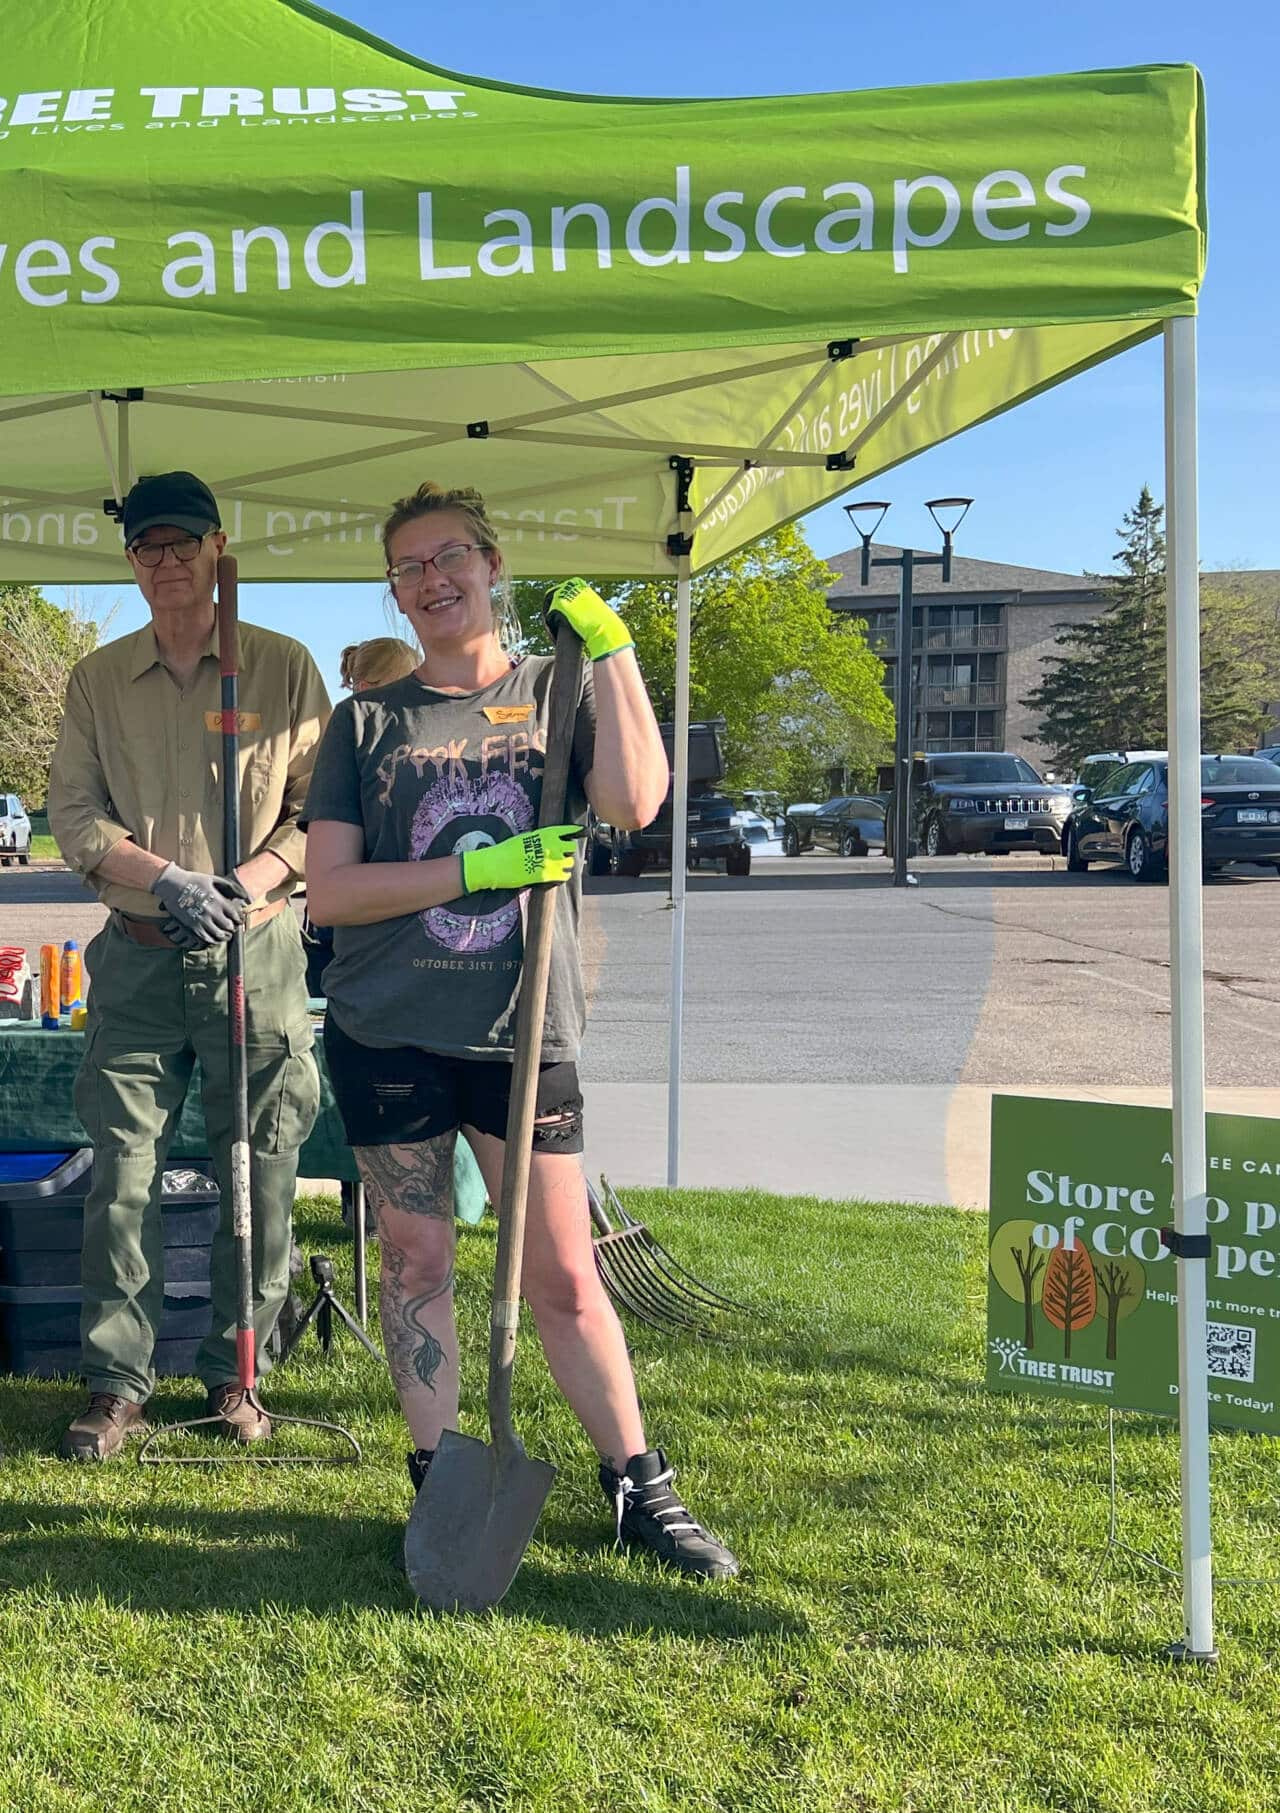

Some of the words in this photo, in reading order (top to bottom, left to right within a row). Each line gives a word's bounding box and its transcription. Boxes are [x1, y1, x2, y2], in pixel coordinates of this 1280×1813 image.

[139, 86, 466, 118] TRUST
[30, 122, 125, 136] Lives
[144, 118, 218, 130] and
[241, 111, 479, 127] Landscapes
[161, 190, 367, 298] and
[418, 164, 1091, 281] Landscapes
[413, 958, 465, 970] OCTOBER
[1026, 1170, 1155, 1216] Store
[1032, 1216, 1086, 1253] of
[1225, 1302, 1266, 1317] more
[1017, 1358, 1057, 1380] TREE
[1060, 1364, 1115, 1388] TRUST
[1225, 1392, 1275, 1414] Today!
